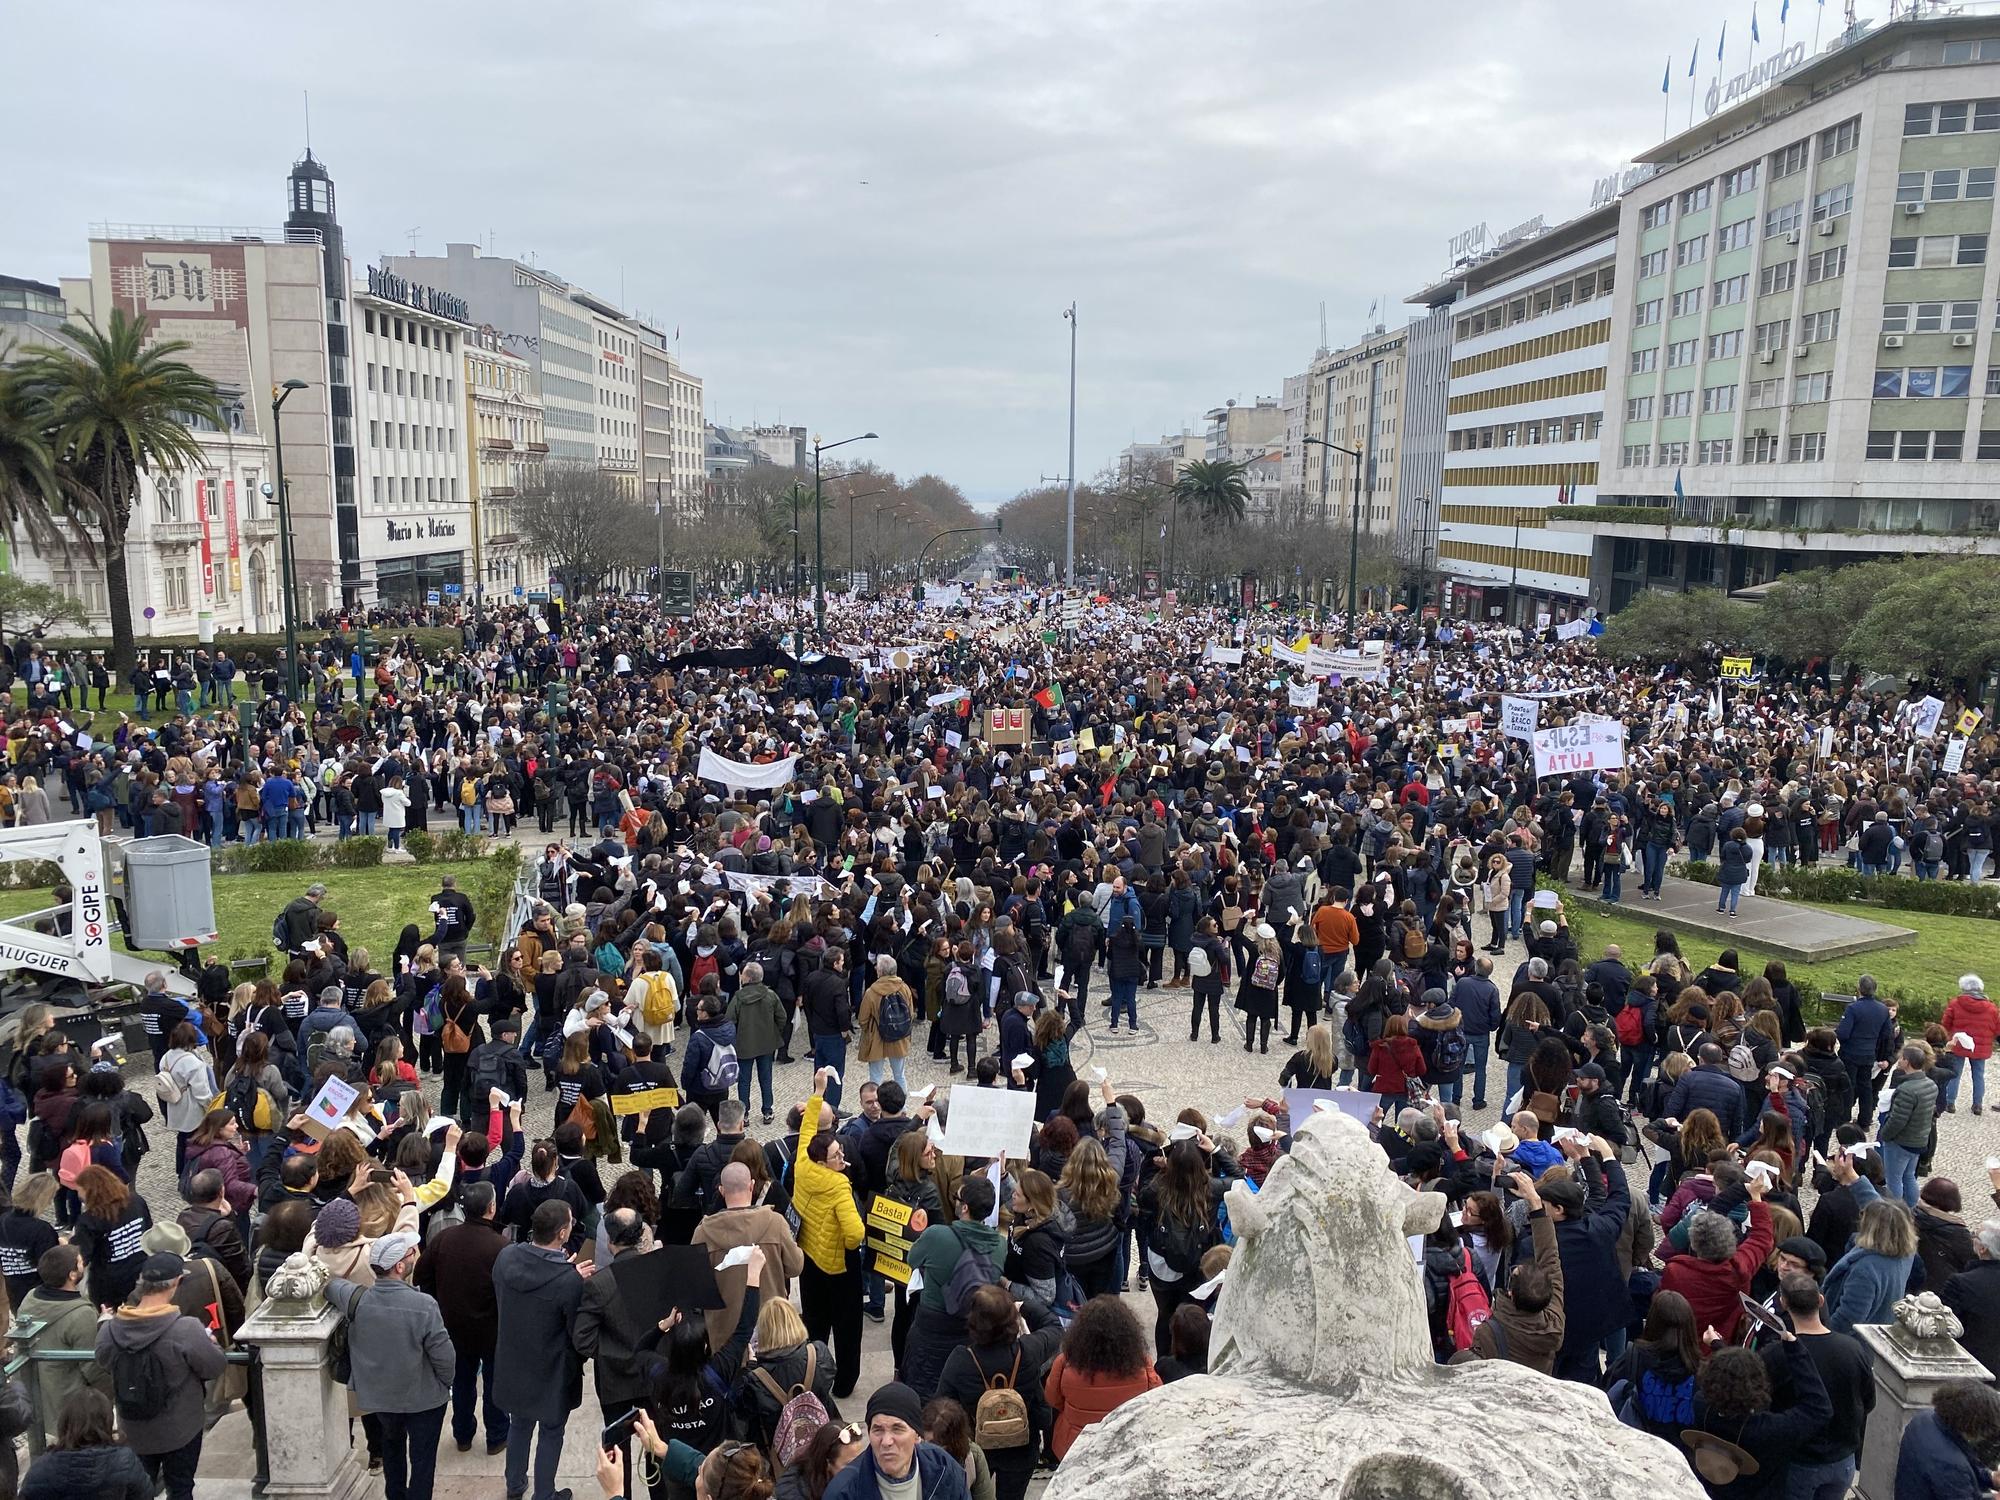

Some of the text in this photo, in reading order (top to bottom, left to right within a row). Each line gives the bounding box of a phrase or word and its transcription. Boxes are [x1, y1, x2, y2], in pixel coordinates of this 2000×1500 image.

[1724, 41, 1805, 103] ATLANTICO
[1591, 172, 1620, 204] AON
[415, 521, 424, 539] de
[82, 885, 102, 946] SOGIPE
[876, 1202, 907, 1221] Basta!
[877, 1255, 910, 1275] Respeito!
[671, 1420, 706, 1430] JUSTA
